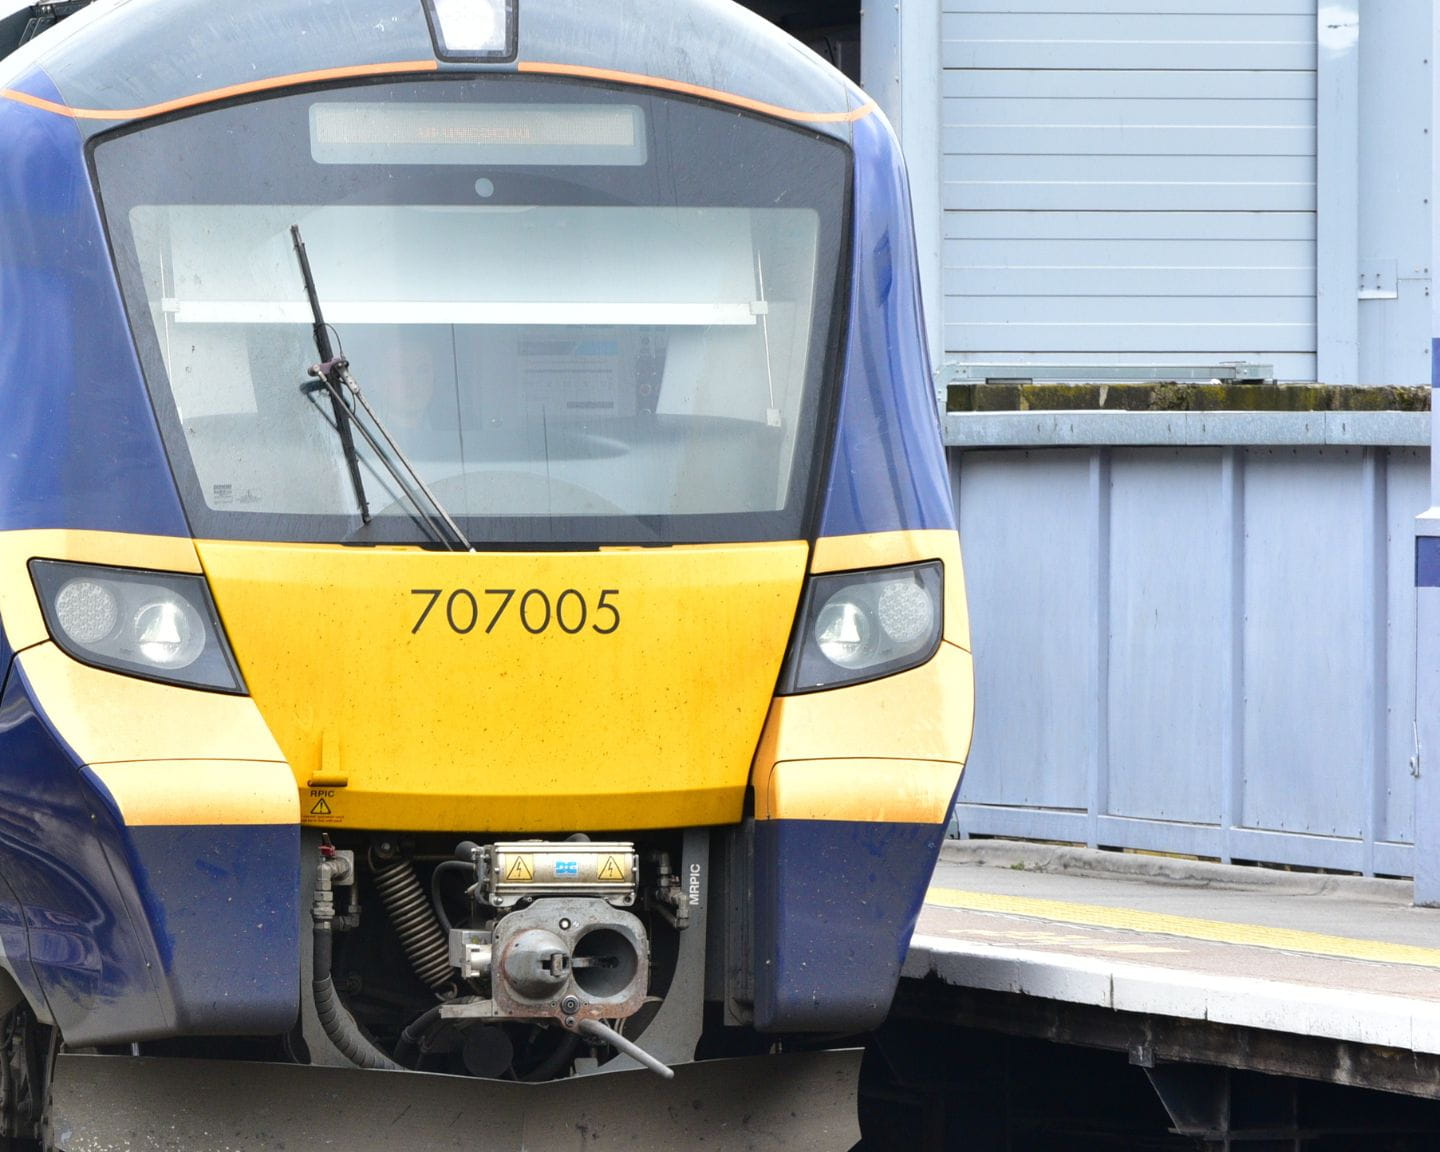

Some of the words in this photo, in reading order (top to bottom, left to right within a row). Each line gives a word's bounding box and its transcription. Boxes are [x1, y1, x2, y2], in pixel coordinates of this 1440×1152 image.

[411, 588, 620, 635] 707005
[310, 790, 335, 798] RPIC
[689, 863, 701, 905] MRPIC
